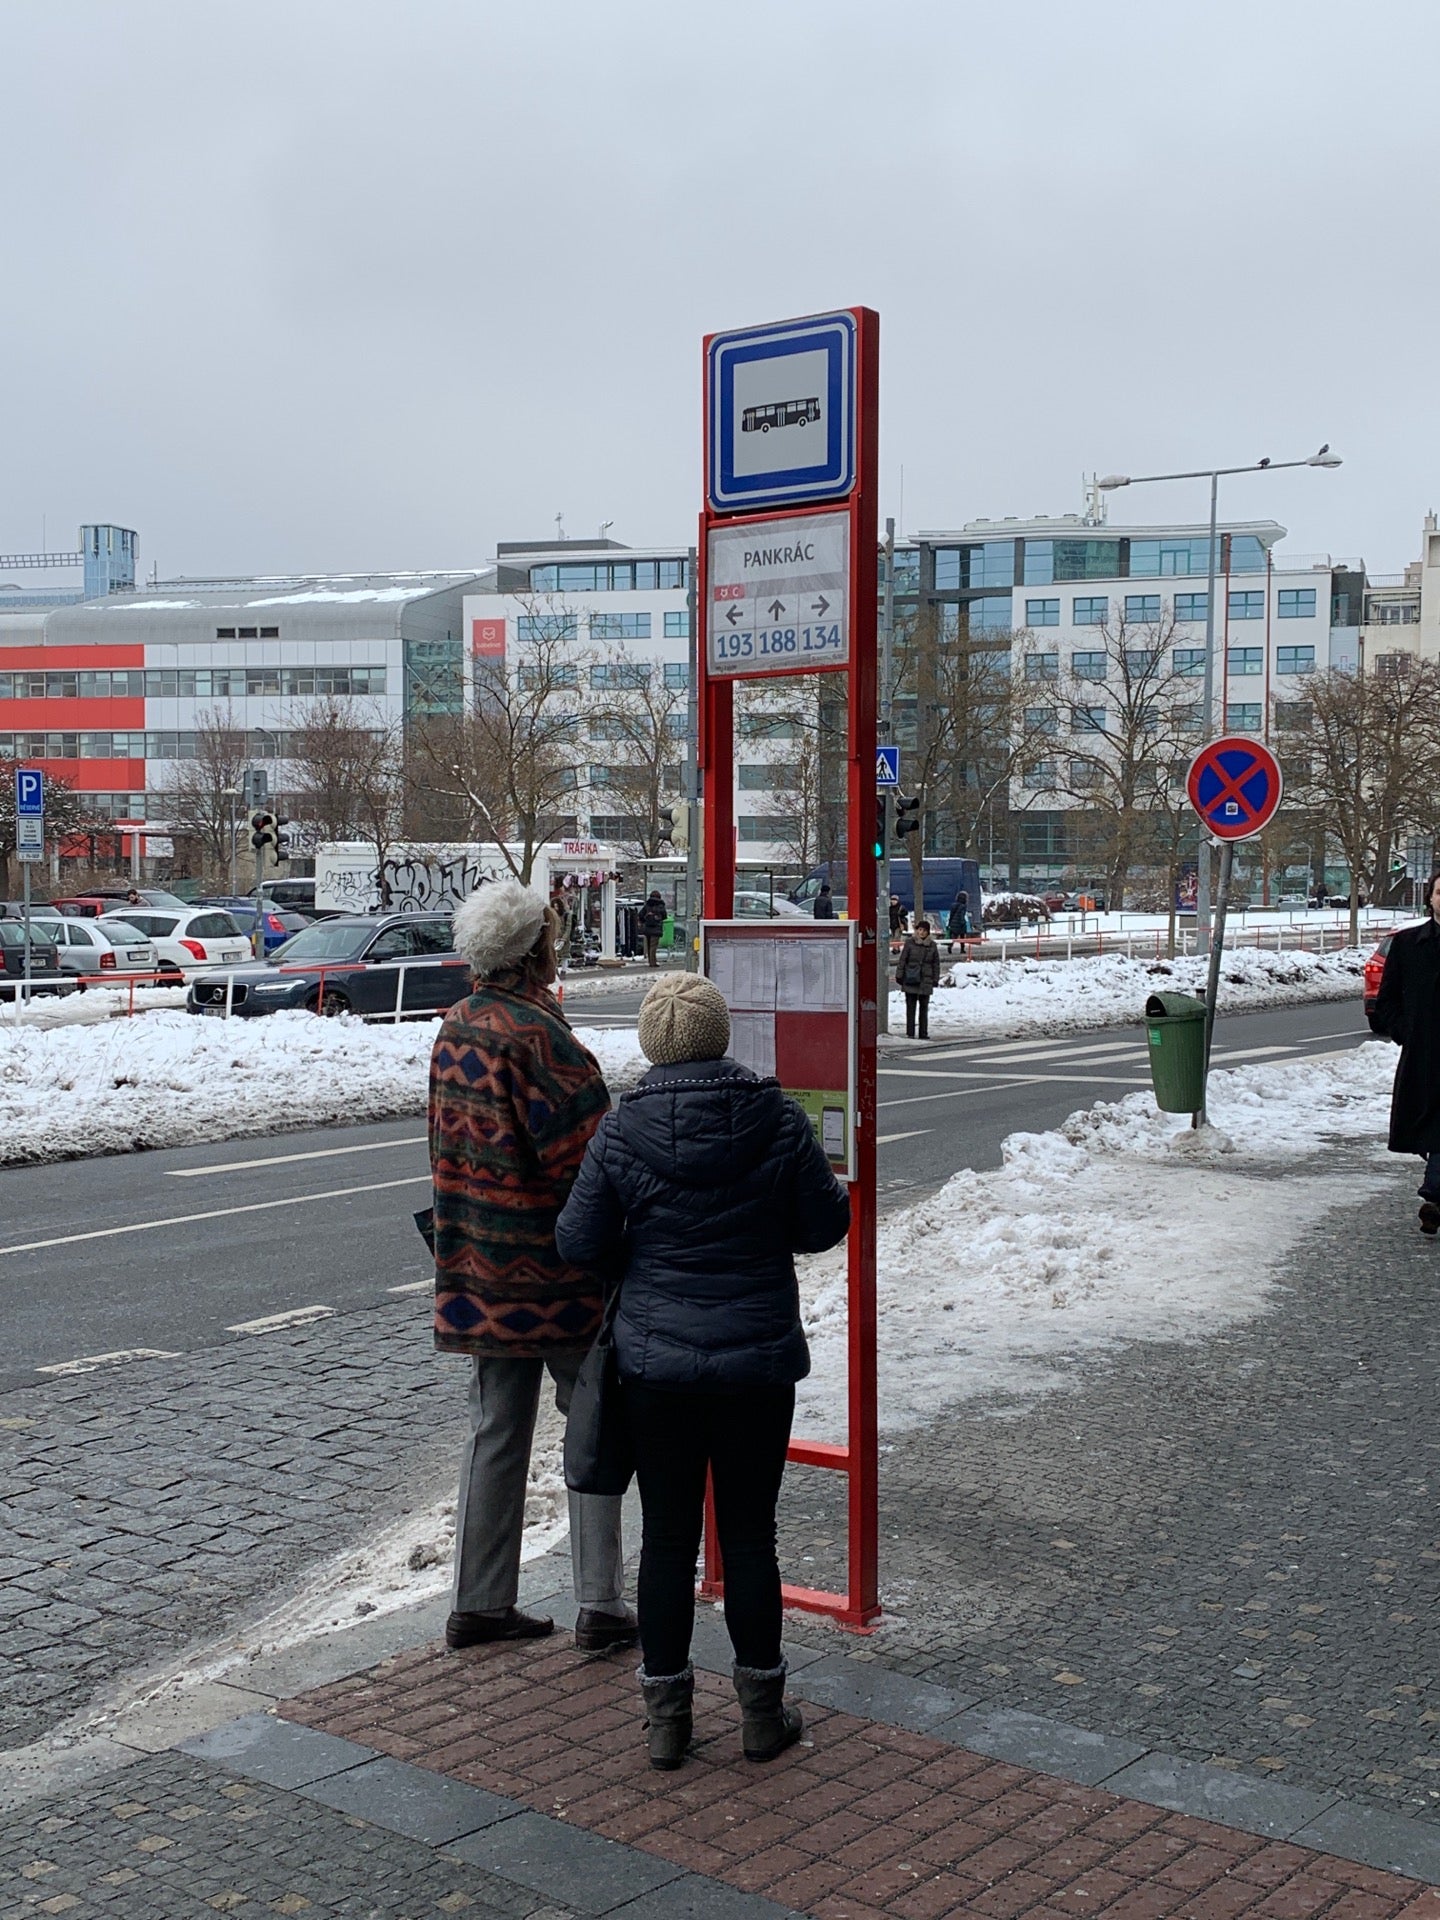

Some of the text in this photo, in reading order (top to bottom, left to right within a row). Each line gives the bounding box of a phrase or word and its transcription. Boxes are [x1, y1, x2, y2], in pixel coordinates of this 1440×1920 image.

[744, 540, 815, 568] PANKRÁC
[732, 587, 739, 597] C
[717, 624, 841, 658] 193 188 134
[22, 775, 37, 802] P
[563, 841, 599, 854] TRAFIKA
